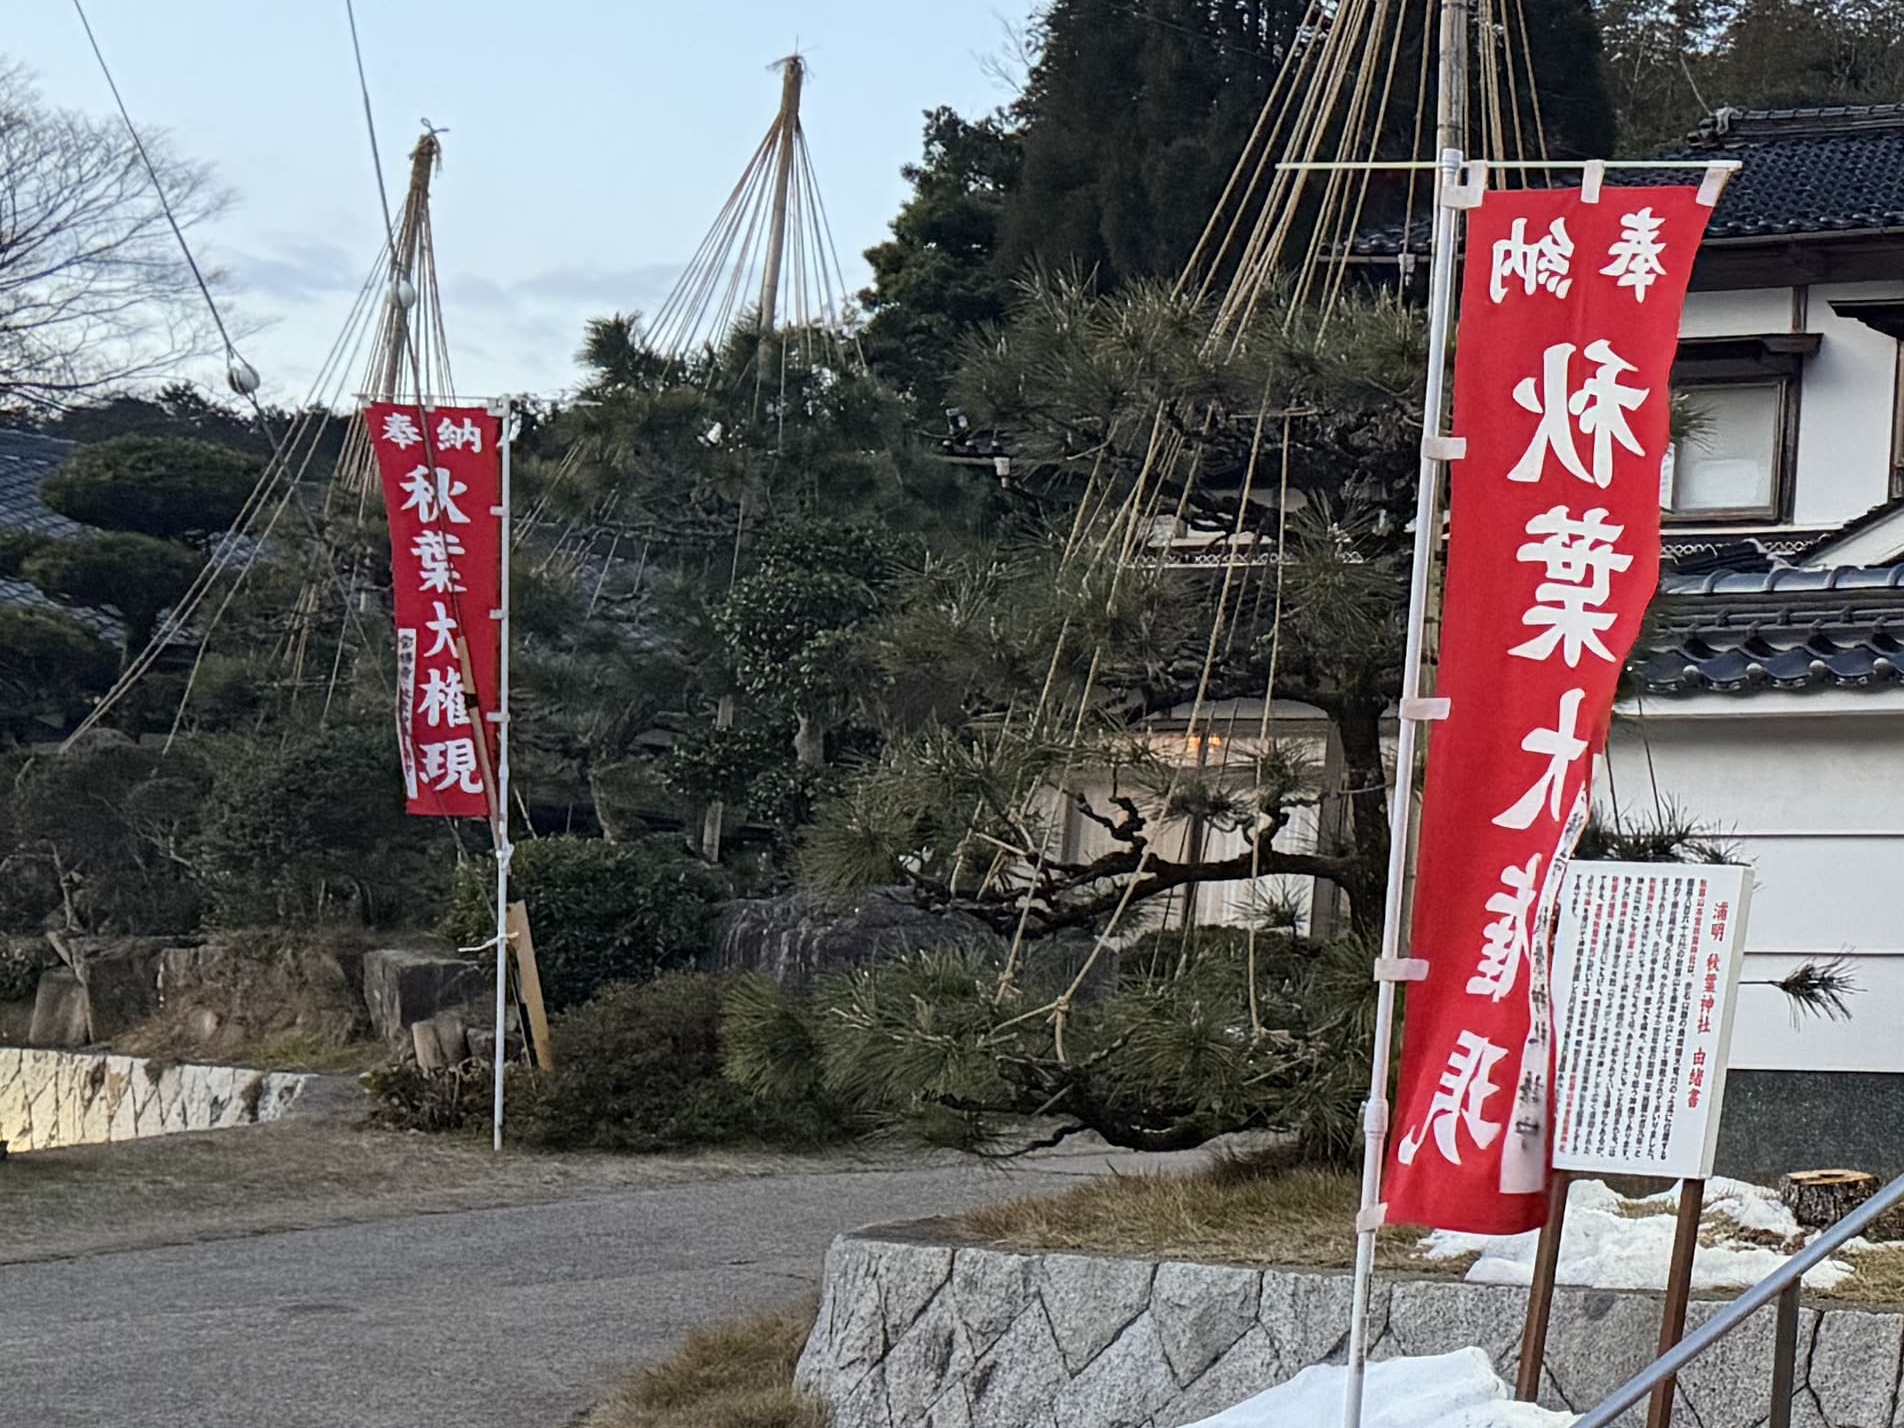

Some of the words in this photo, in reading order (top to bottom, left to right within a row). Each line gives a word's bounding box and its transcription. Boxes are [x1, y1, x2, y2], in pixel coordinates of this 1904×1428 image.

[381, 412, 482, 453] 奉納
[400, 464, 484, 793] 秋葉大権現
